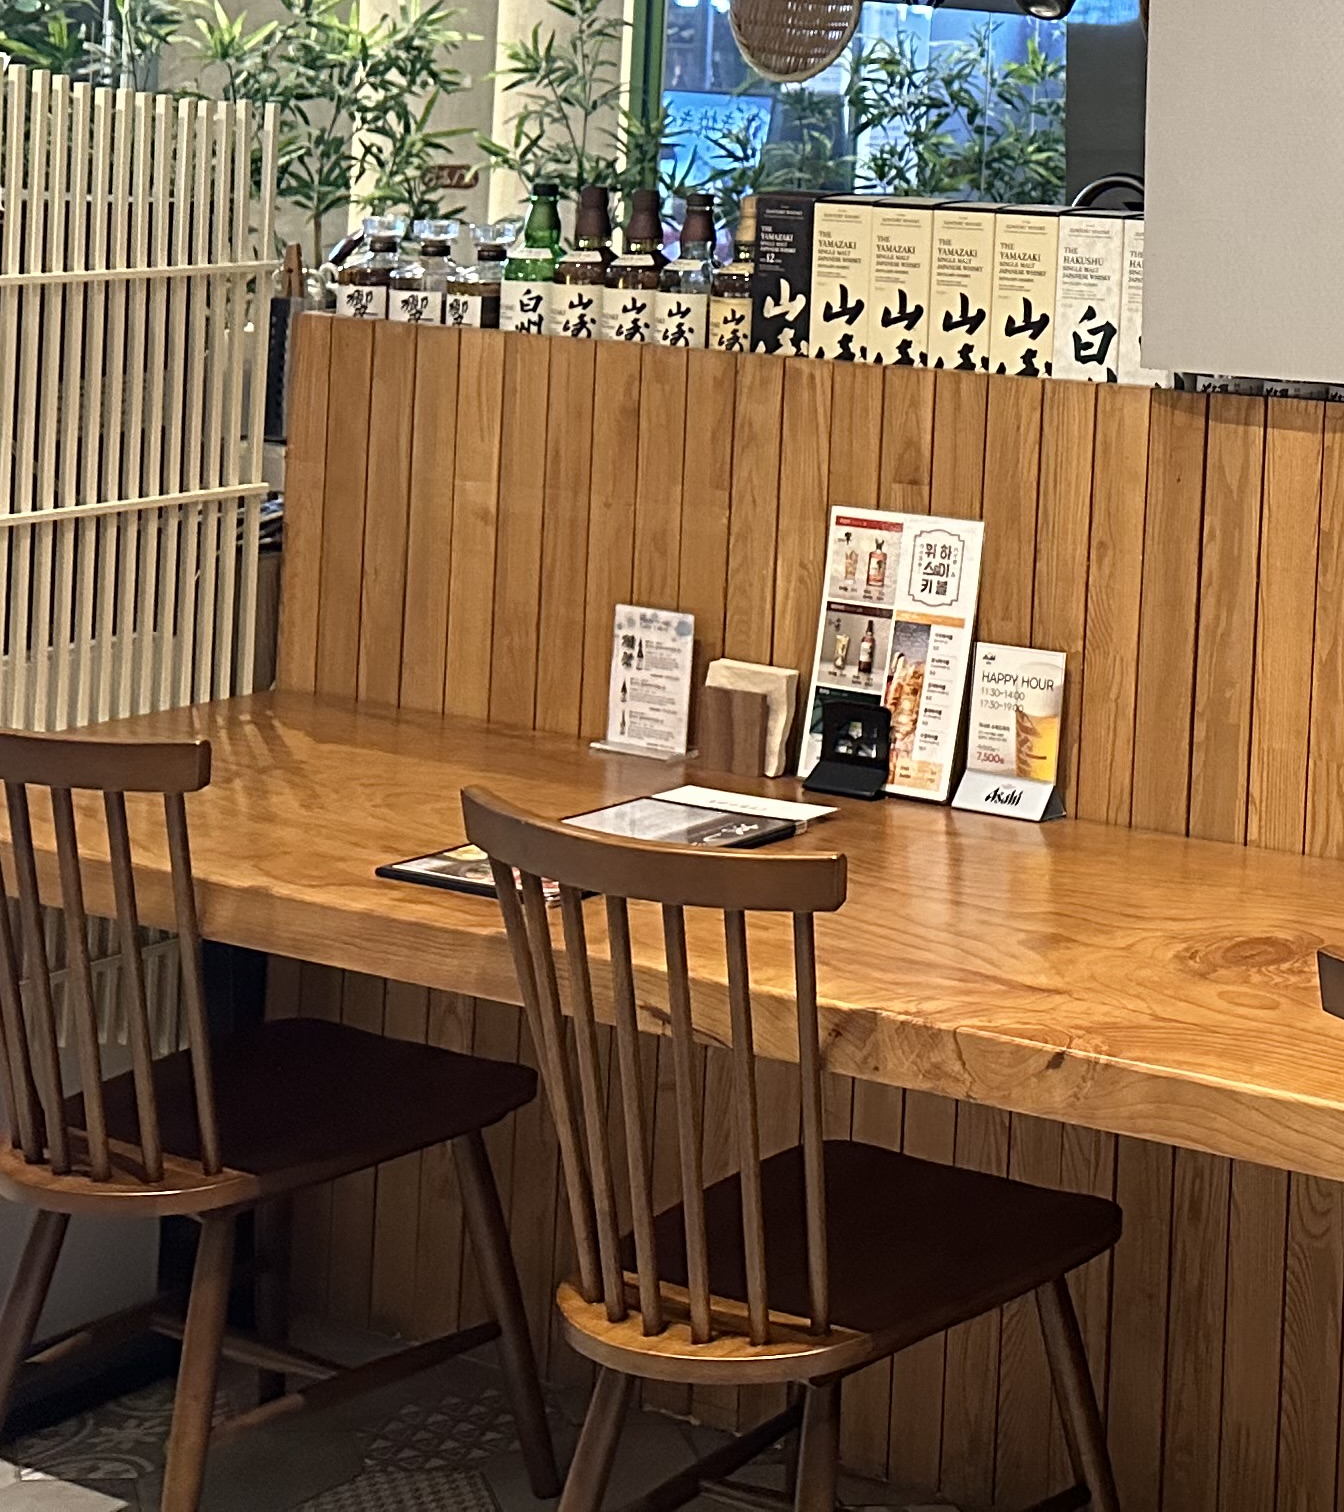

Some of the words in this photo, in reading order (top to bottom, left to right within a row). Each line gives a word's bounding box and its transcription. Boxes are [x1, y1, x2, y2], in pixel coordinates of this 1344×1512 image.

[760, 232, 794, 242] YAMAZAKI
[818, 240, 857, 250] YAMAZAKI
[876, 244, 916, 254] YAMAZAKI
[937, 248, 978, 258] YAMAZAKI
[1000, 251, 1041, 262] YAMAZAKI
[1064, 255, 1104, 266] HAKUSHU
[982, 672, 1018, 686] HAPPY
[1021, 675, 1054, 691] HOUR
[985, 788, 1023, 806] Asahi
